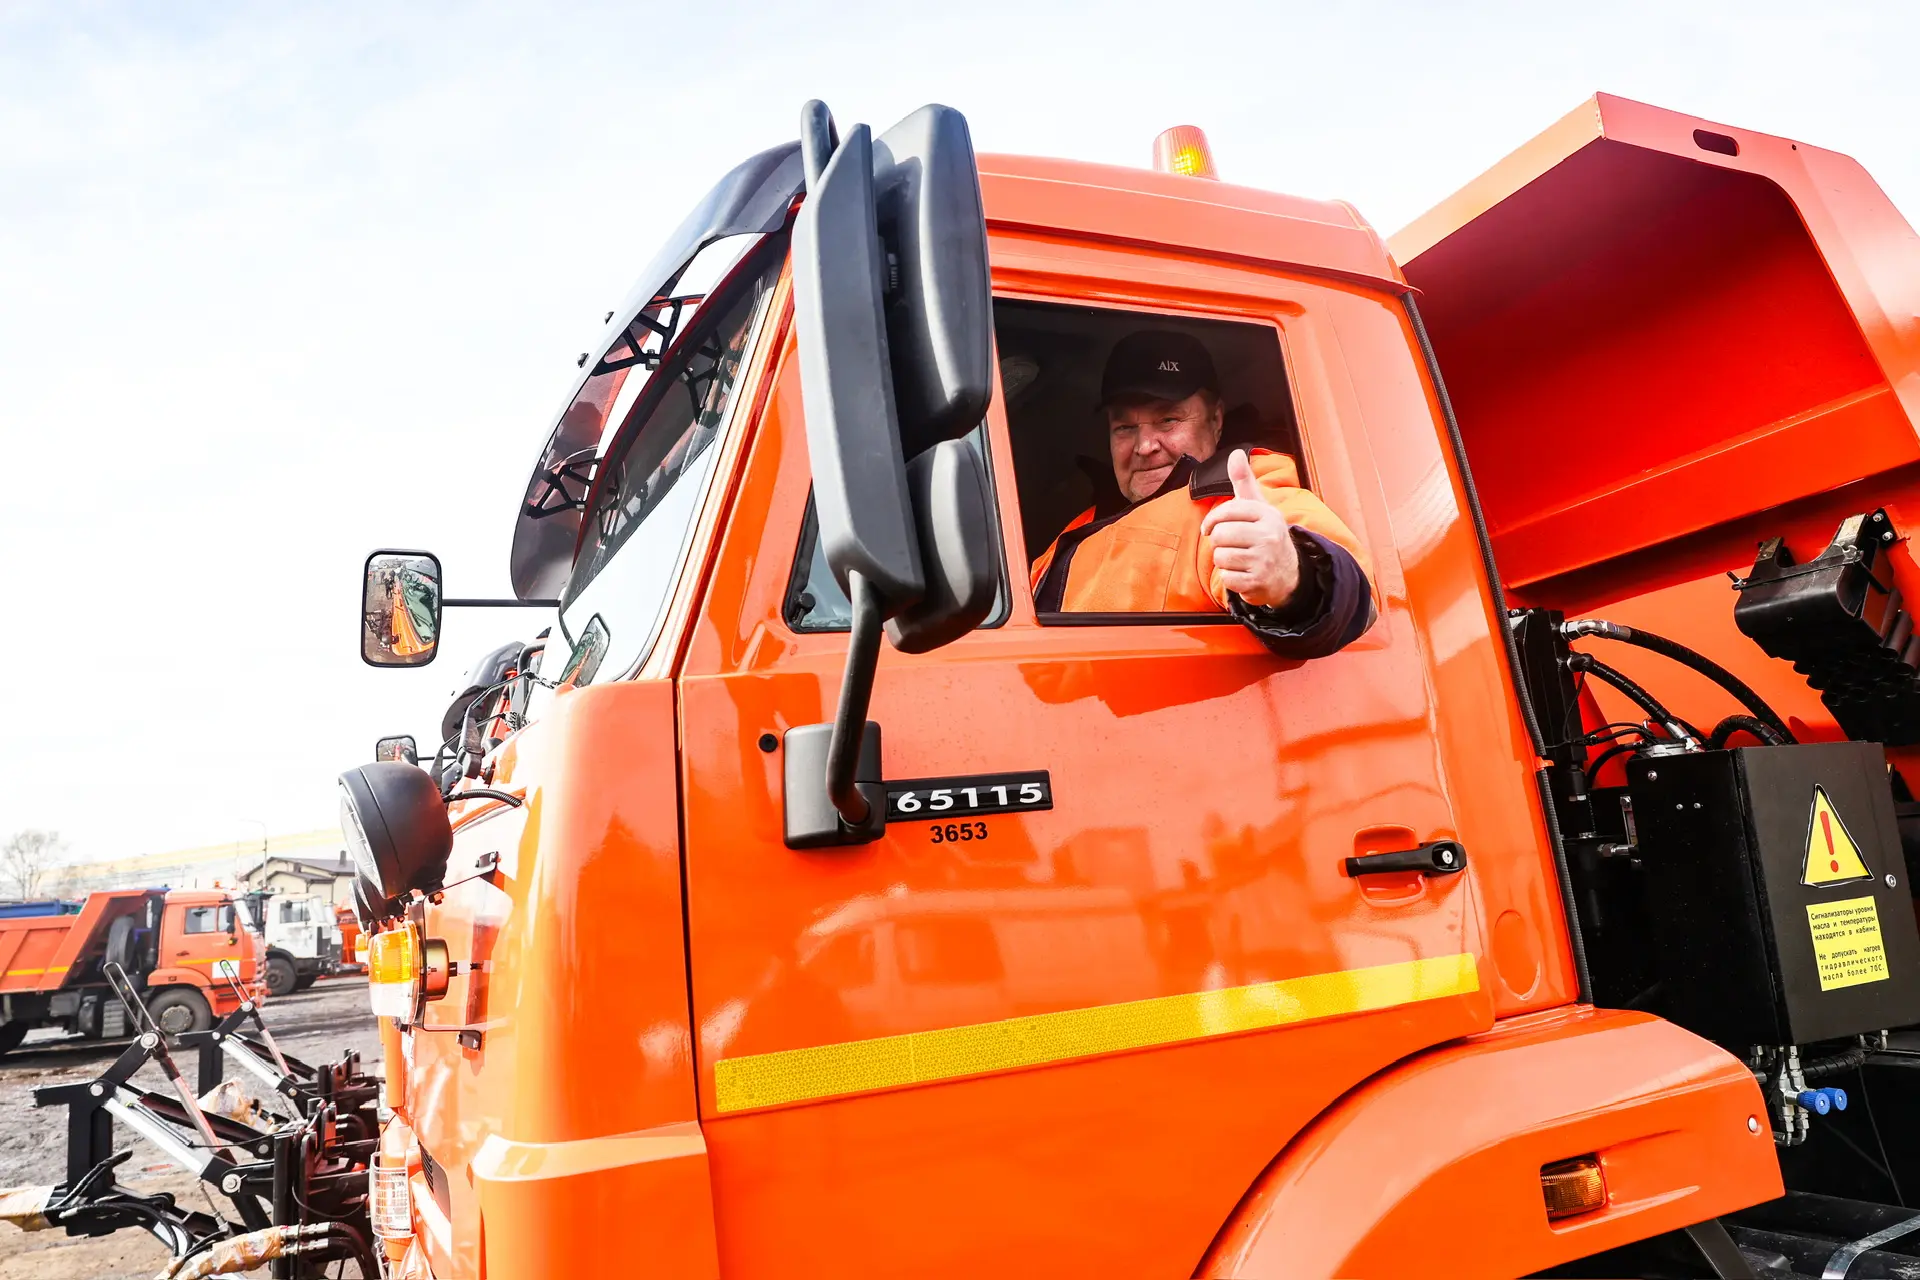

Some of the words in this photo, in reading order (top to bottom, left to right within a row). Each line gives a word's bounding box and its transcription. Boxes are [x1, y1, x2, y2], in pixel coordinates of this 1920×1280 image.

[897, 783, 1043, 813] 65115
[930, 822, 988, 844] 3653
[1811, 909, 1854, 920] Сигнализаторы
[1855, 906, 1874, 915] уровня
[1813, 922, 1830, 930] масла
[1840, 916, 1876, 926] температуры
[1815, 930, 1845, 940] находятся
[1856, 925, 1878, 934] кабине.
[1832, 948, 1857, 959] допускать
[1864, 945, 1880, 953] нагрев
[1821, 955, 1883, 971] гидравлического
[1823, 972, 1843, 981] масла
[1847, 967, 1867, 977] более
